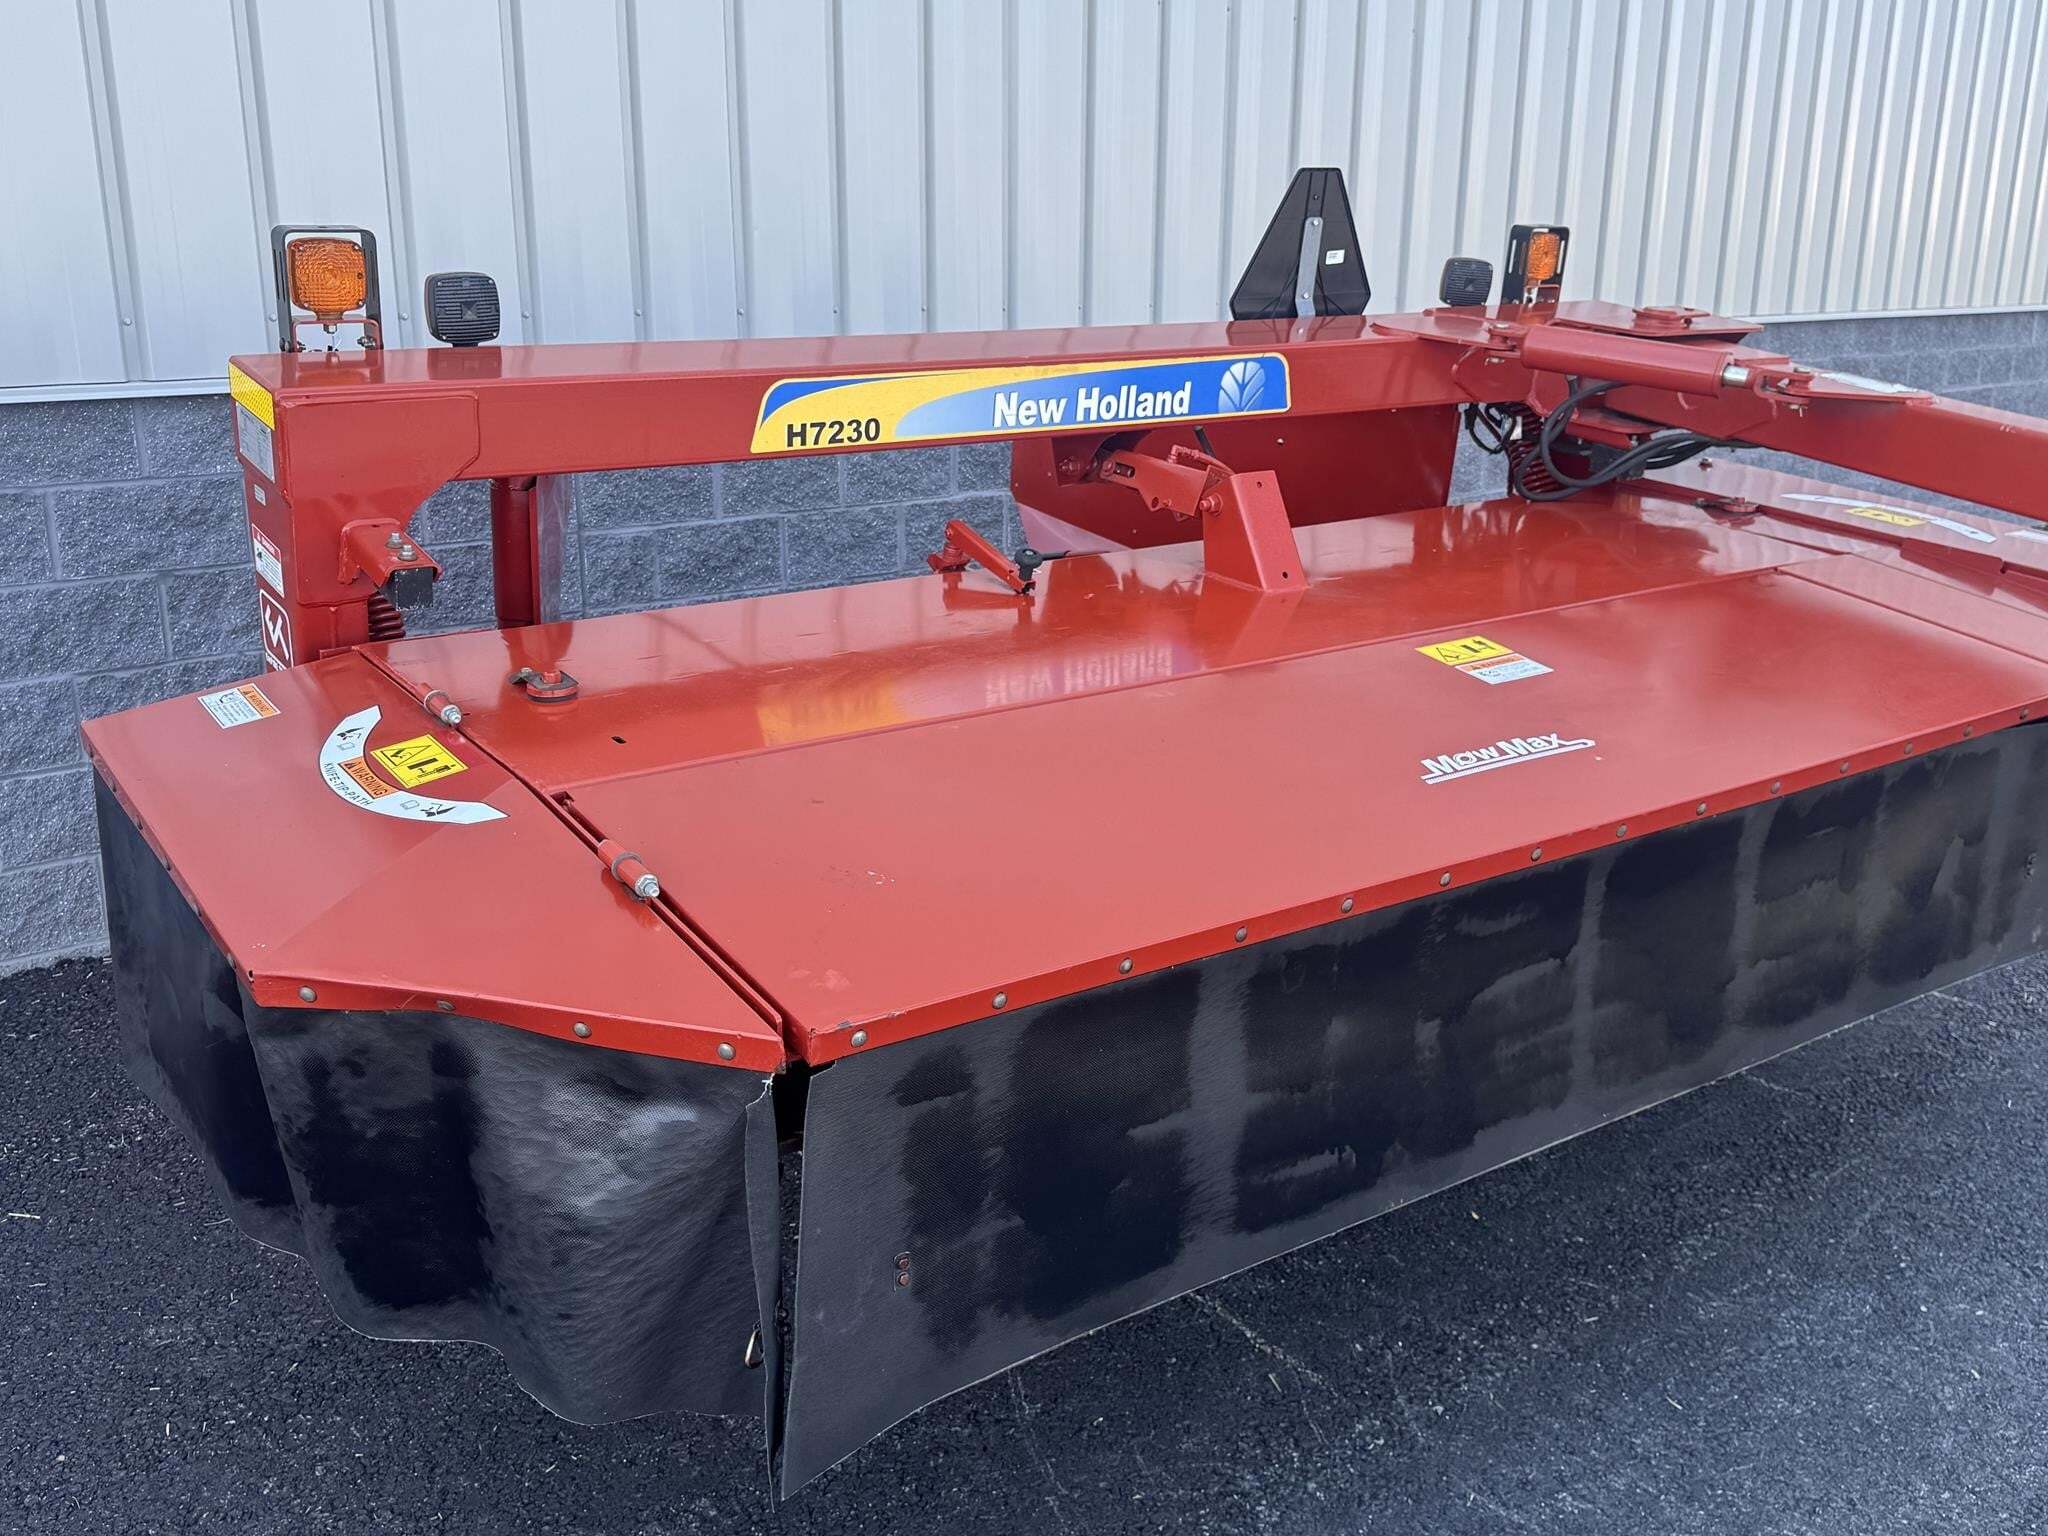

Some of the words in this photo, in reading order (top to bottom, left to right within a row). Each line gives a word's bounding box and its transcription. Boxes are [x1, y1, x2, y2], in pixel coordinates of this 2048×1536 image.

[993, 391, 1065, 429] New
[1075, 381, 1192, 422] Holland
[786, 417, 880, 448] H7230
[352, 760, 388, 796] WARNING
